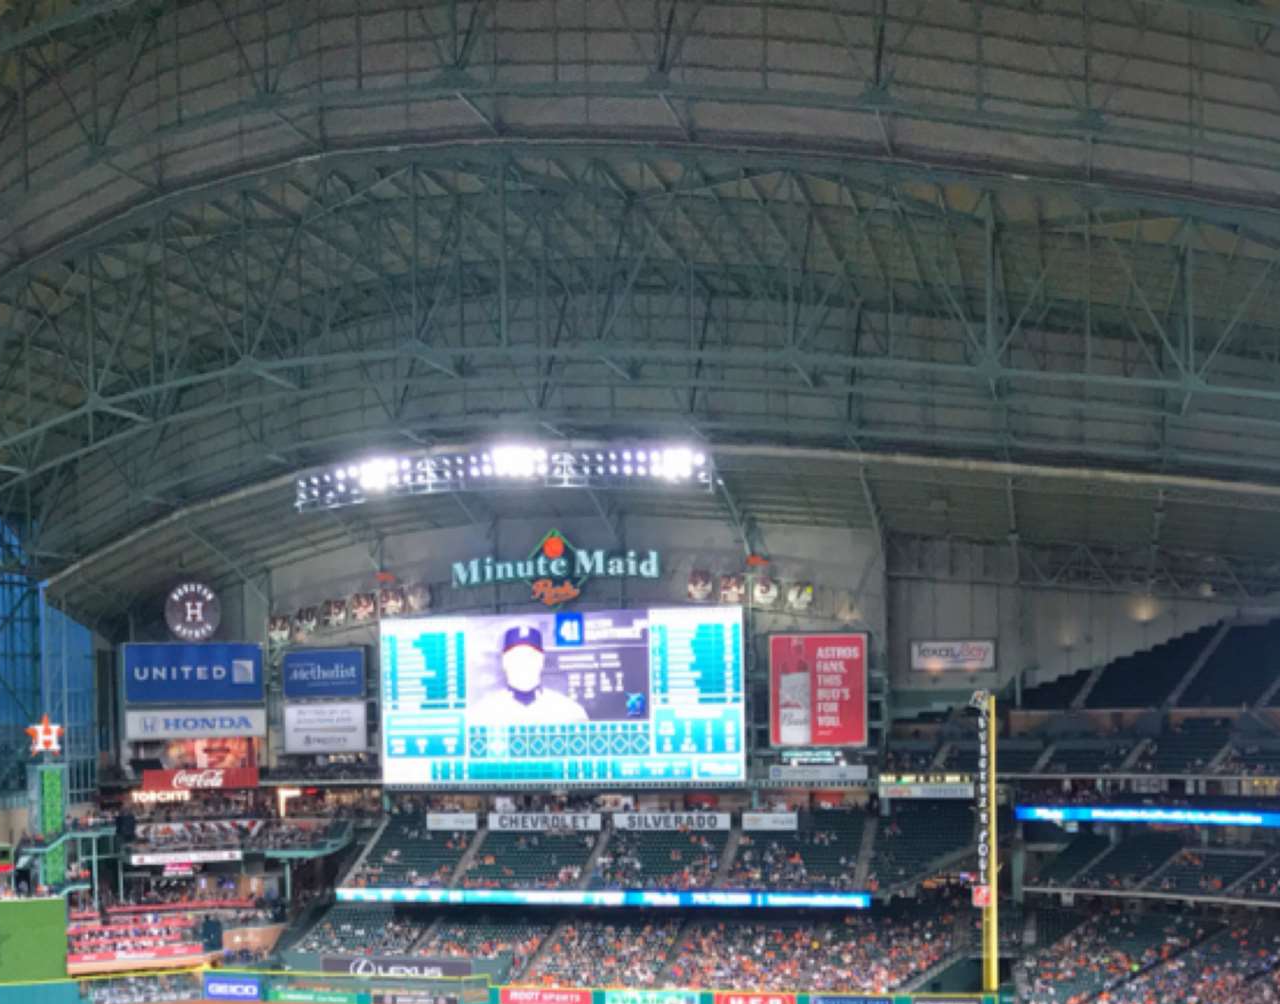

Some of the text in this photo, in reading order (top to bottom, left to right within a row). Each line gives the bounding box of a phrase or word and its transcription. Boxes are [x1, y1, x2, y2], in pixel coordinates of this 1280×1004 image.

[452, 555, 568, 588] Minute
[575, 549, 660, 579] Maid
[184, 601, 202, 622] H
[133, 666, 226, 681] UNITED
[162, 716, 253, 732] HONDA
[31, 725, 61, 750] H
[498, 814, 591, 829] CHEVROLET
[627, 814, 719, 829] SILVERADO
[207, 982, 258, 997] GEICO
